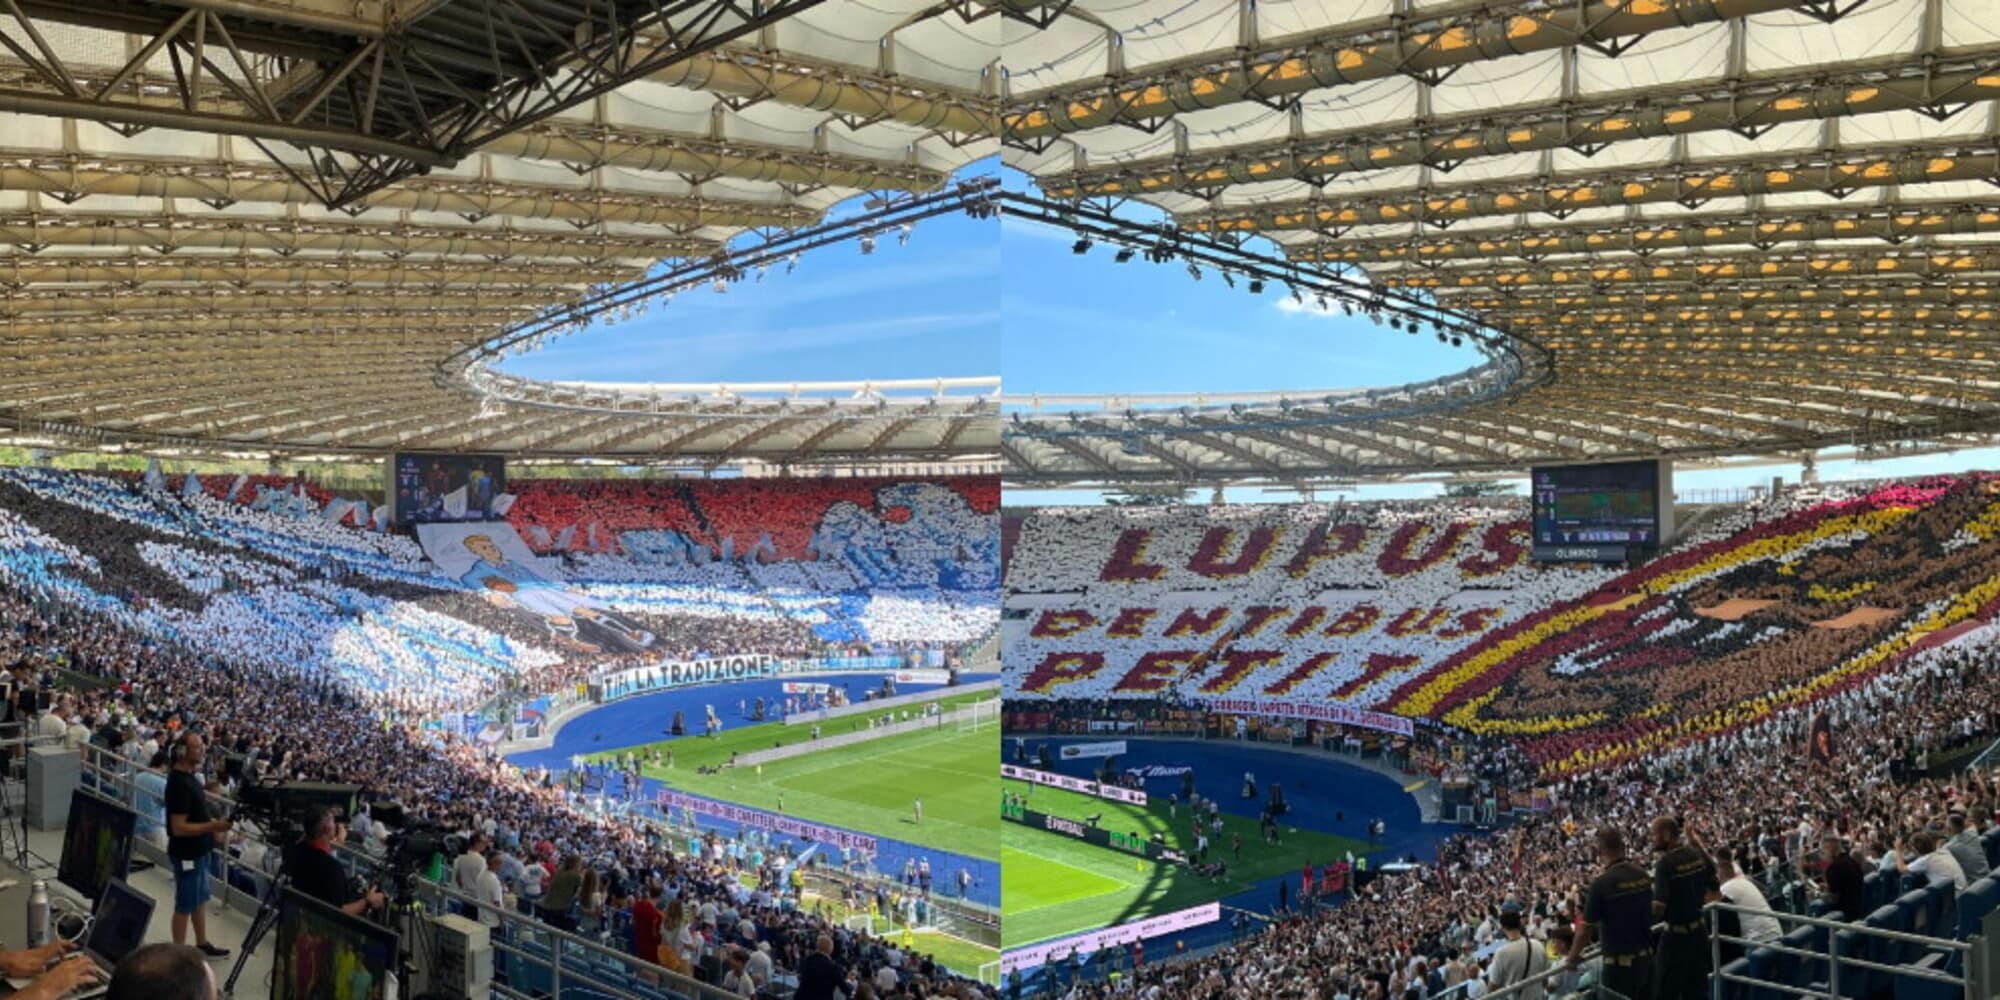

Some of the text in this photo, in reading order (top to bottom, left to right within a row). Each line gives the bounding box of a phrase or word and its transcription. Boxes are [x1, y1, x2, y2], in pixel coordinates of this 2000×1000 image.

[1101, 521, 1530, 582] LUPUS
[1556, 548, 1598, 559] OLIMPICO
[1029, 606, 1506, 640] DENTIBUS
[635, 668, 656, 688] LA
[660, 656, 770, 685] TRADIZIONE
[1018, 650, 1424, 700] PETIT
